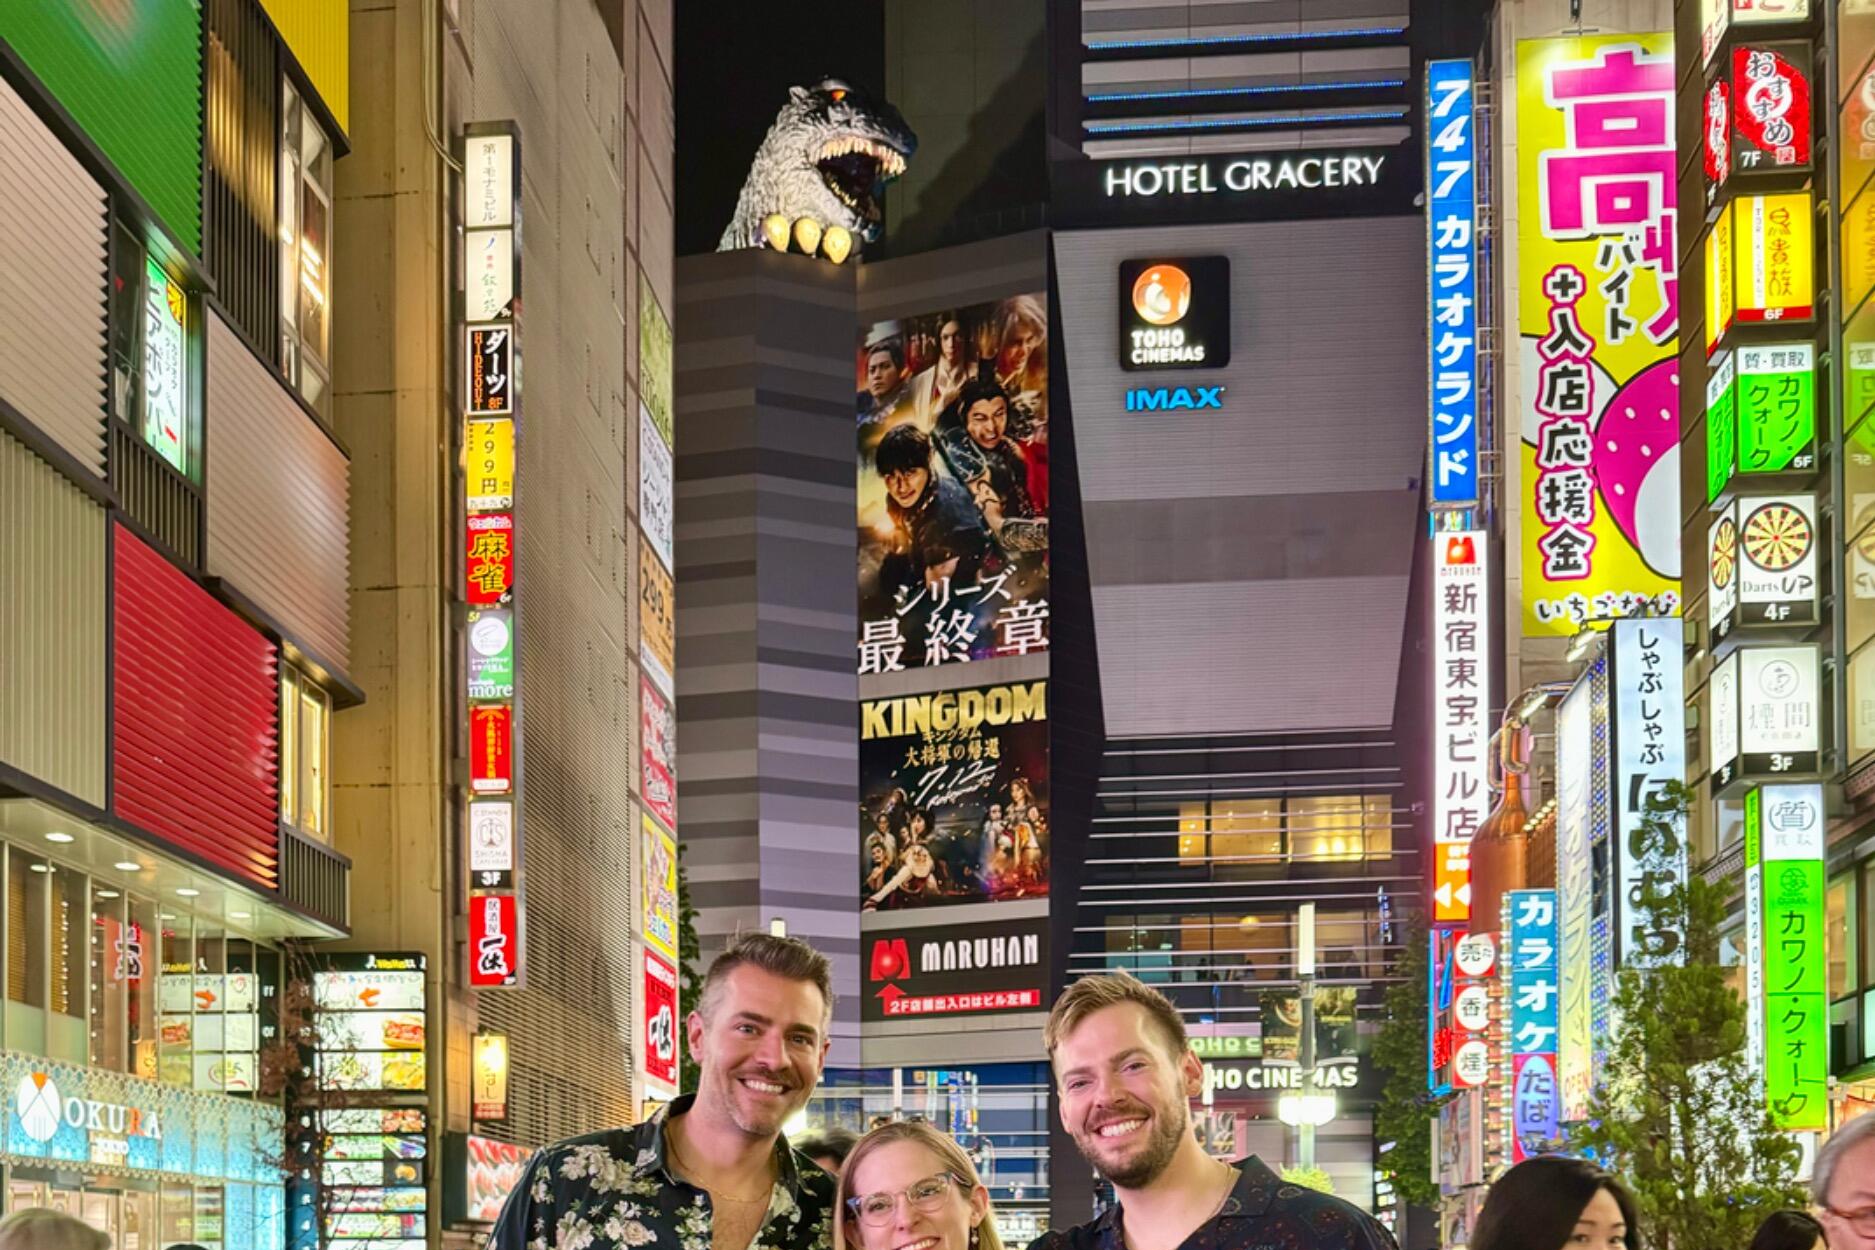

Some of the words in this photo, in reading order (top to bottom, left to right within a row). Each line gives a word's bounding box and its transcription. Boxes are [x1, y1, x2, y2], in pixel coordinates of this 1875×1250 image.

[1747, 51, 1793, 144] おすすめ
[1106, 164, 1217, 197] HOTEL
[1224, 155, 1386, 191] GRACERY
[1740, 150, 1761, 167] 7F
[1600, 234, 1638, 340] バイト
[1764, 308, 1784, 320] 6F
[1131, 329, 1185, 349] TOHO
[1131, 346, 1205, 364] CINEMAS
[485, 330, 507, 394] ダーツ
[1125, 386, 1223, 411] IMAX
[1749, 385, 1771, 468] クォーク
[482, 422, 497, 494] 299円
[469, 530, 508, 593] 麻雀
[894, 564, 1018, 617] シリーズ
[1743, 581, 1779, 592] Darts
[1782, 575, 1814, 595] UP
[1764, 603, 1791, 620] 4F
[857, 598, 1049, 675] 最終章
[468, 685, 513, 698] more
[861, 681, 1048, 740] KINGDOM
[1444, 582, 1479, 839] 新宿東宝ビル店
[1638, 628, 1664, 765] しゃぶしゃぶ
[914, 761, 997, 806] 7.12
[1769, 753, 1794, 771] 3F
[481, 871, 501, 886] 3F
[482, 938, 503, 971] 一休
[920, 934, 1039, 973] MARUHAN
[1516, 895, 1556, 1053] カラオケ
[64, 1097, 162, 1140] OKURA
